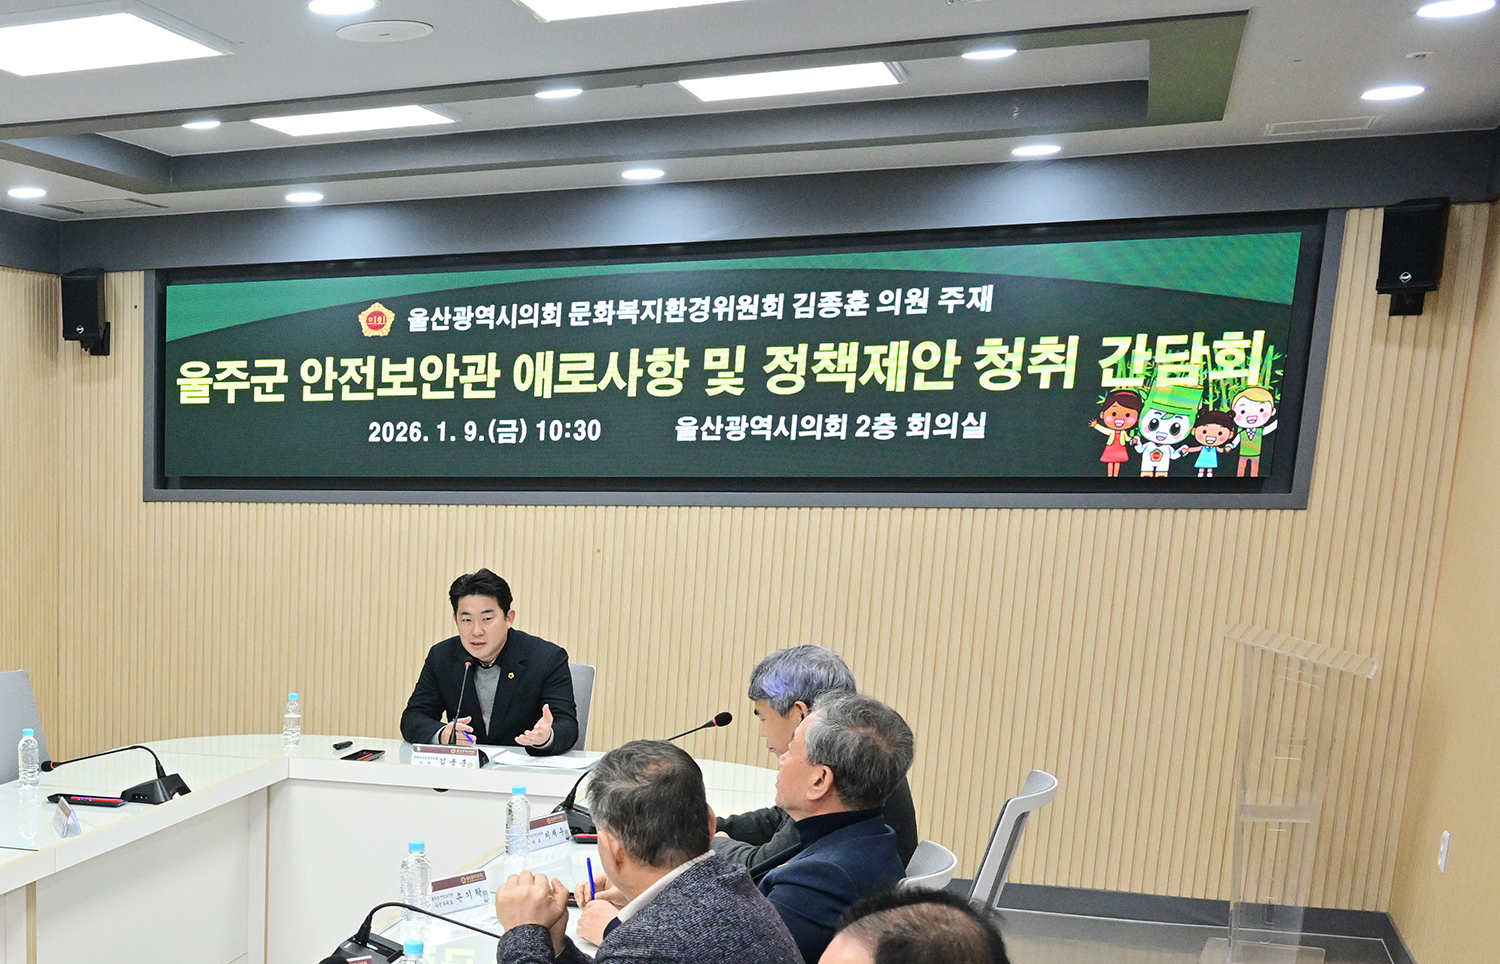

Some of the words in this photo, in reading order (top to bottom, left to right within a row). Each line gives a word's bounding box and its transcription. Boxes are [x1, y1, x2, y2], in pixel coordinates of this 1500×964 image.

[367, 316, 386, 325] 의회
[407, 302, 562, 332] 울산광역시의회
[568, 293, 785, 326] 문화복지환경위원회
[792, 290, 870, 320] 김종훈
[876, 287, 930, 316] 의원
[937, 284, 994, 313] 주재
[176, 359, 289, 404] 울주군
[299, 352, 501, 402] 안전보안관
[513, 347, 690, 399] 애로사항
[703, 345, 746, 396] 및
[762, 338, 962, 395] 정책제안
[974, 335, 1080, 391] 청취
[1098, 330, 1266, 388] 간담회
[368, 421, 429, 443] 2026.
[536, 419, 601, 442] 10:30
[675, 414, 848, 442] 울산광역시의회
[855, 413, 898, 440] 2층
[906, 411, 987, 440] 회의실
